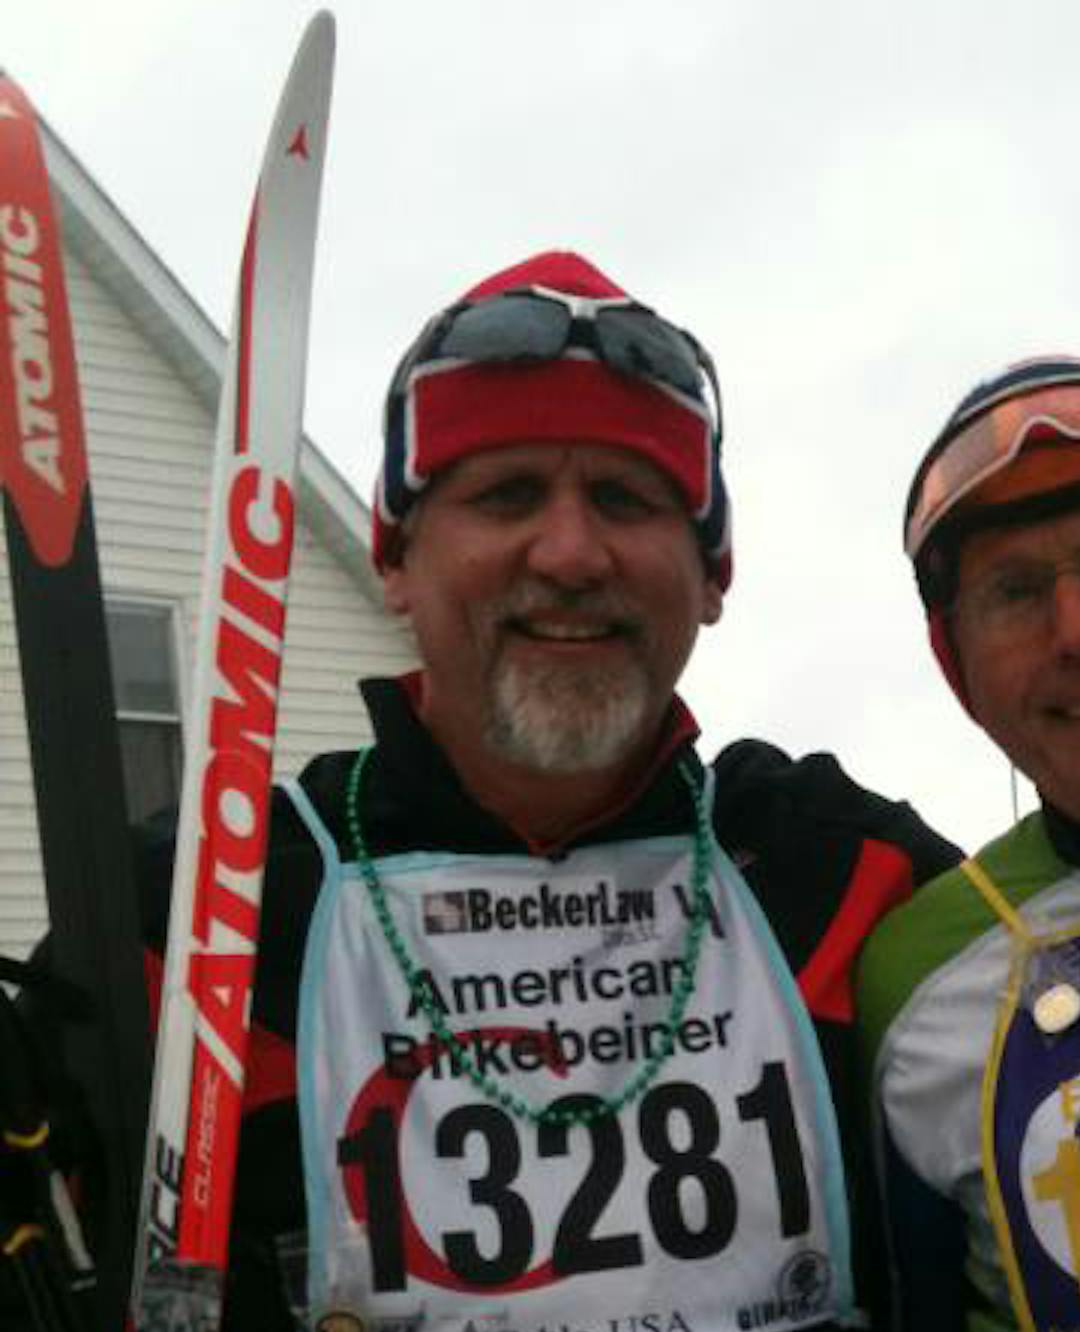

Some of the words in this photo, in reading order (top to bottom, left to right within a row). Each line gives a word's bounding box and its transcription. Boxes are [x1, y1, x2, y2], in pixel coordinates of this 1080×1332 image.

[1, 205, 66, 494] ATOMIC
[186, 464, 295, 1068] ATOMIC
[466, 880, 656, 932] BeckerLaw
[381, 1006, 734, 1080] Birkebeiner
[406, 954, 697, 1019] American
[337, 1060, 811, 1294] 13281
